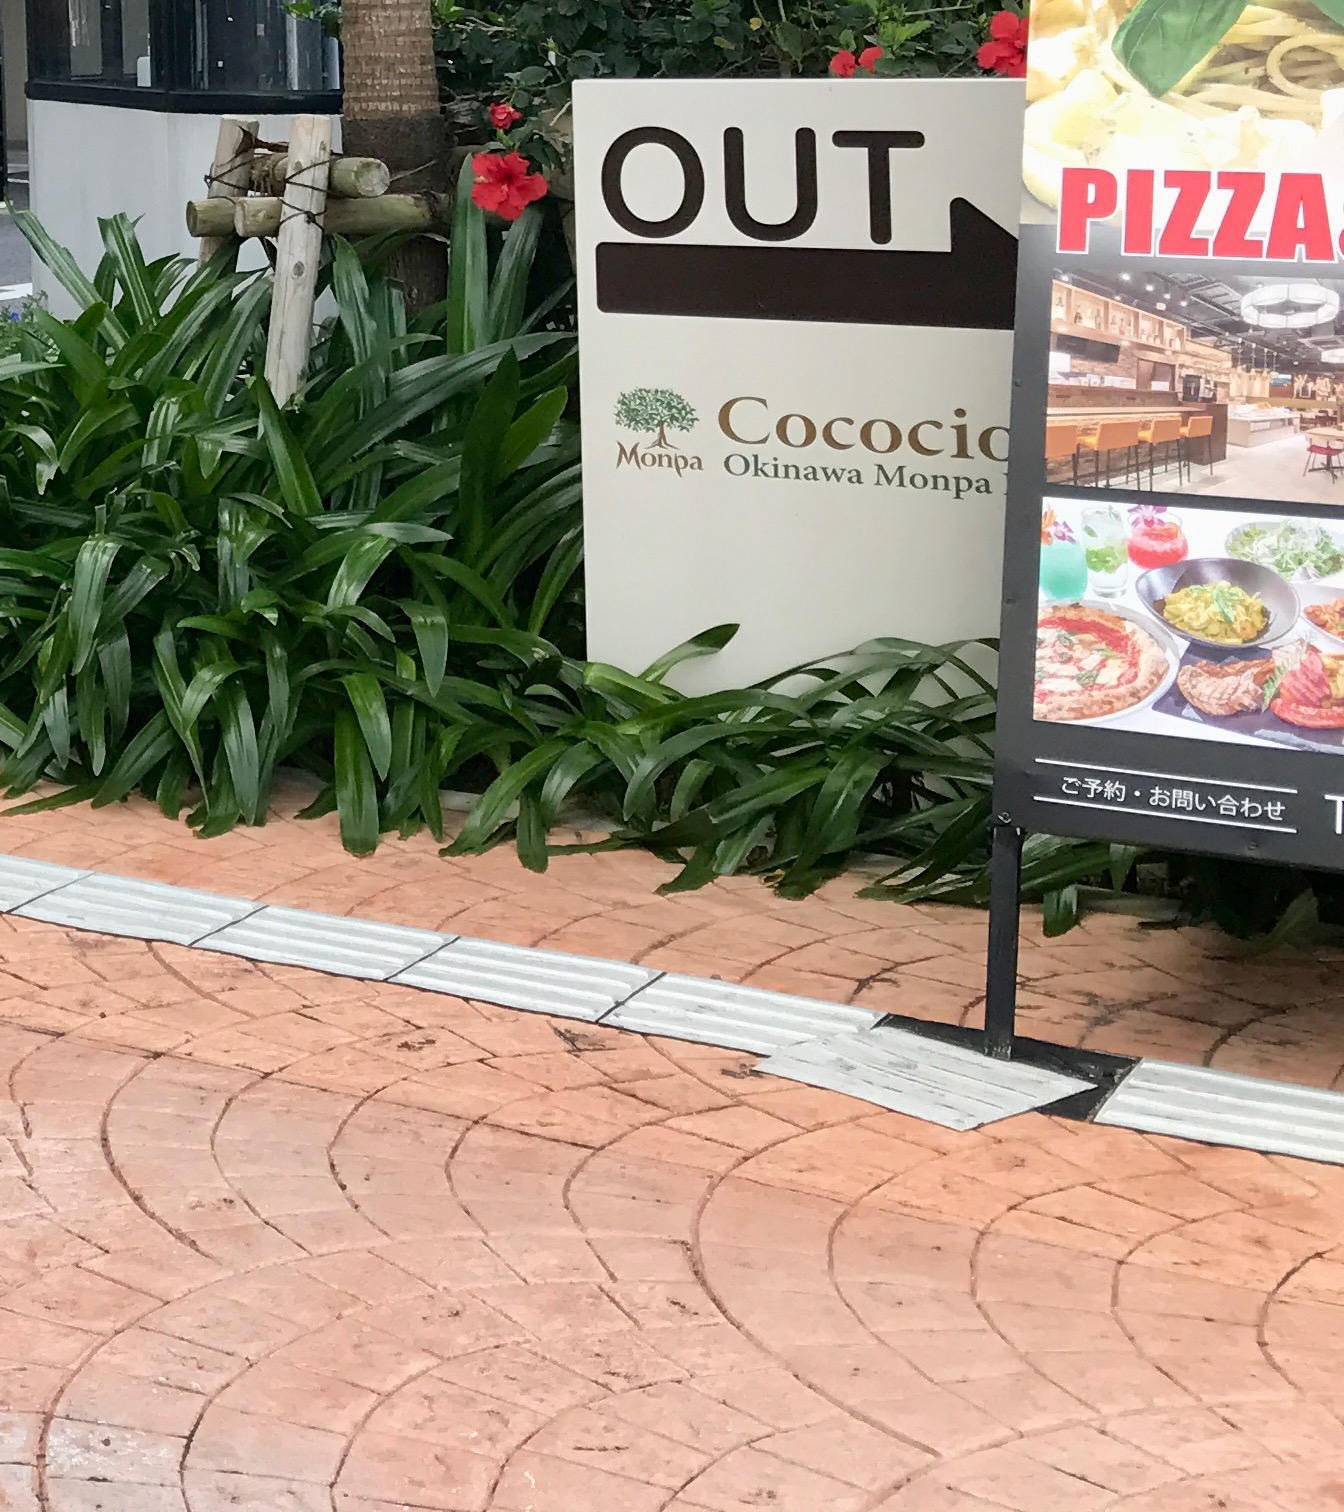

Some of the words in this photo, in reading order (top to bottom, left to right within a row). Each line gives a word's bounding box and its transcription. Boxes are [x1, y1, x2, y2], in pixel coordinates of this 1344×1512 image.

[600, 126, 925, 245] OUT
[1058, 167, 1344, 262] PIZZA
[616, 440, 704, 478] Monpa
[723, 453, 864, 485] Okinawa
[874, 463, 992, 500] Monpa
[1062, 776, 1286, 821] ご予約・お問い合わせ
